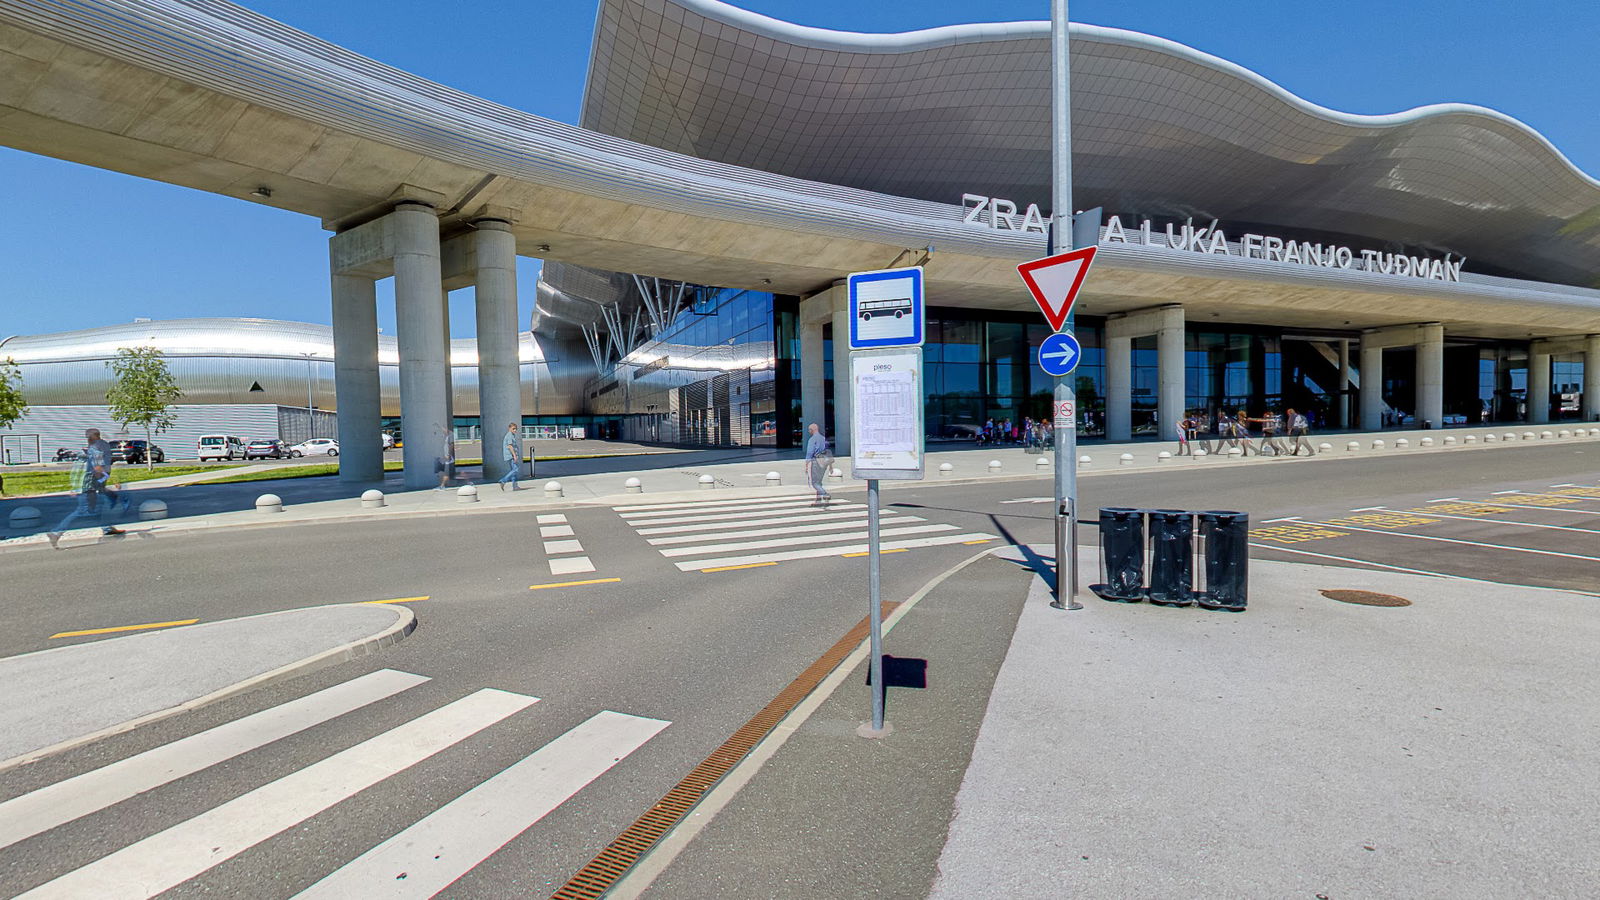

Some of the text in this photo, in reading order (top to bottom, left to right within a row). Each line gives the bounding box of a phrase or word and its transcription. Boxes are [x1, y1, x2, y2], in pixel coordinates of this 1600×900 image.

[962, 193, 1460, 283] ZRAA LUKA FRANJO TUĐMAN
